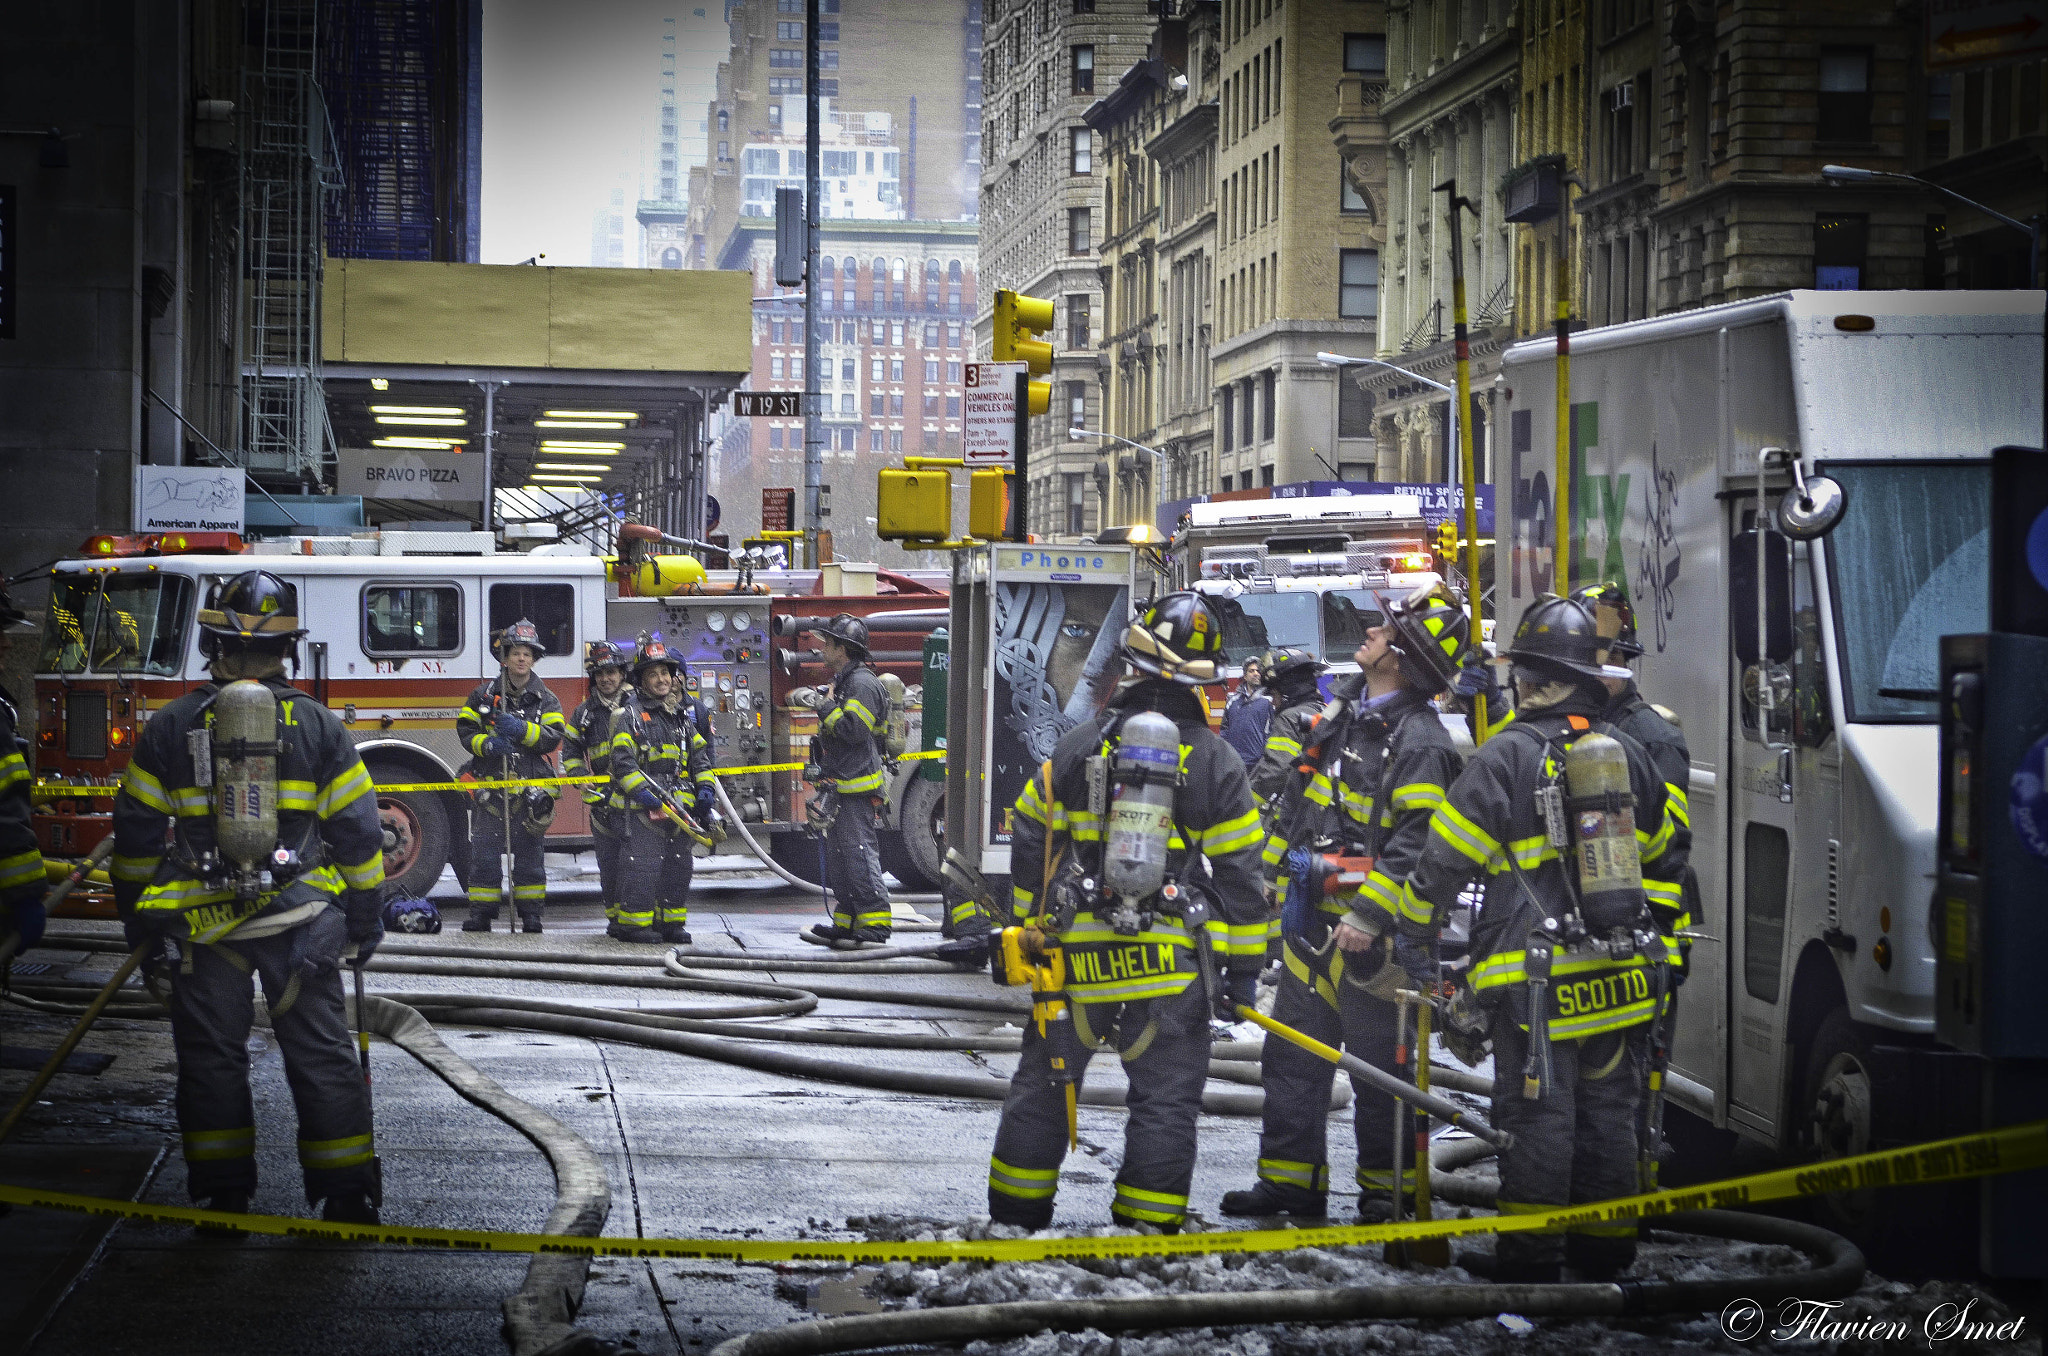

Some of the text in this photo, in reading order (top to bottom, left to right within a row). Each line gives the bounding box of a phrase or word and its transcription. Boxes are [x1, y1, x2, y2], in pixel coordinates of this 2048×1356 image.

[967, 366, 977, 386] 3
[741, 396, 795, 416] W 19 ST
[968, 392, 1013, 402] COMMERCIAL
[968, 403, 1016, 413] VEHICLES ONL
[366, 467, 460, 483] BRAVO PIZZA
[1394, 486, 1433, 497] RETAIL
[147, 518, 239, 531] American Apparel
[1021, 551, 1104, 569] Phone
[422, 661, 447, 674] N.Y.
[225, 783, 236, 820] SCOTT
[248, 783, 260, 819] SCOTT
[1118, 809, 1153, 820] SCOTT
[1584, 842, 1599, 878] SCOTT
[1069, 943, 1176, 982] WILHELM
[1556, 968, 1649, 1016] SCOTTO
